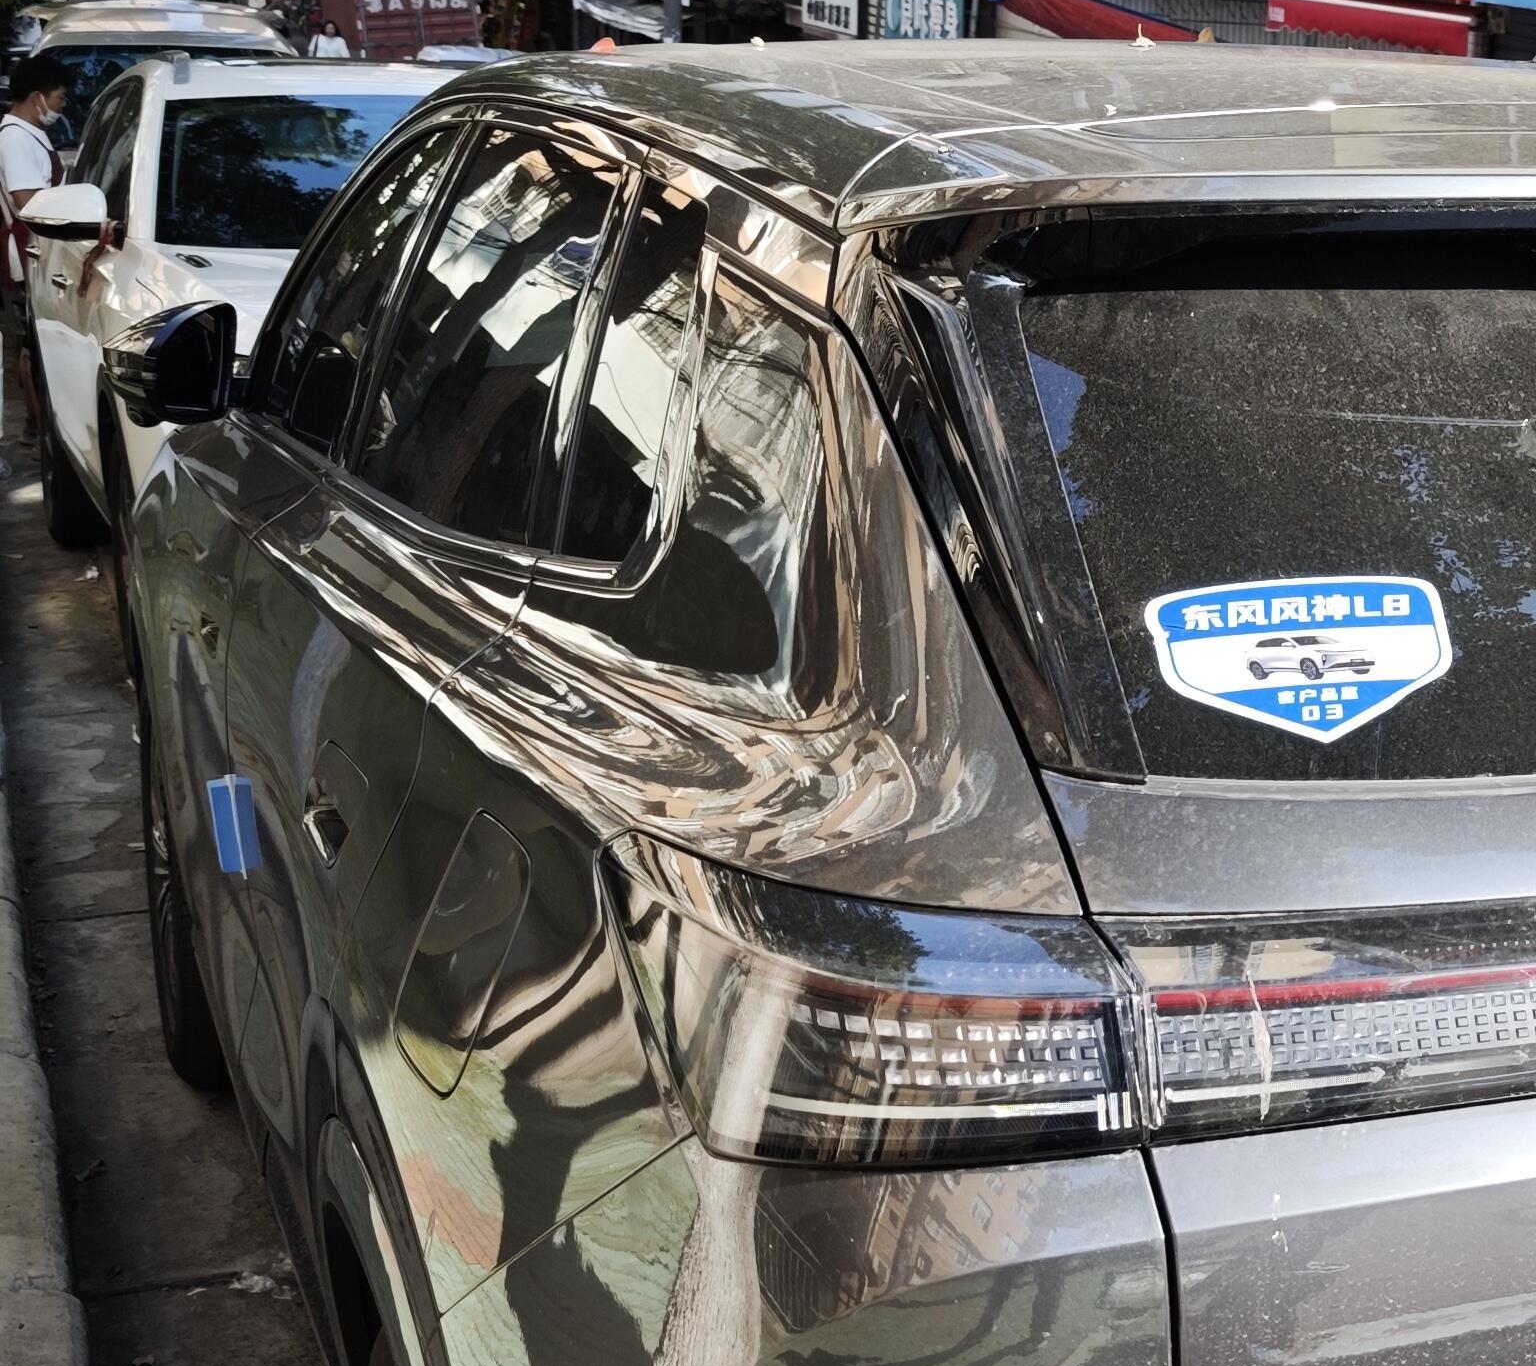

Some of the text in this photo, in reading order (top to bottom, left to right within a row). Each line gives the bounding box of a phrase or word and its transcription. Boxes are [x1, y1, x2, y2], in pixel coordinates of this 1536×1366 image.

[1181, 593, 1411, 631] 东风风神L8
[1301, 703, 1344, 722] 03
